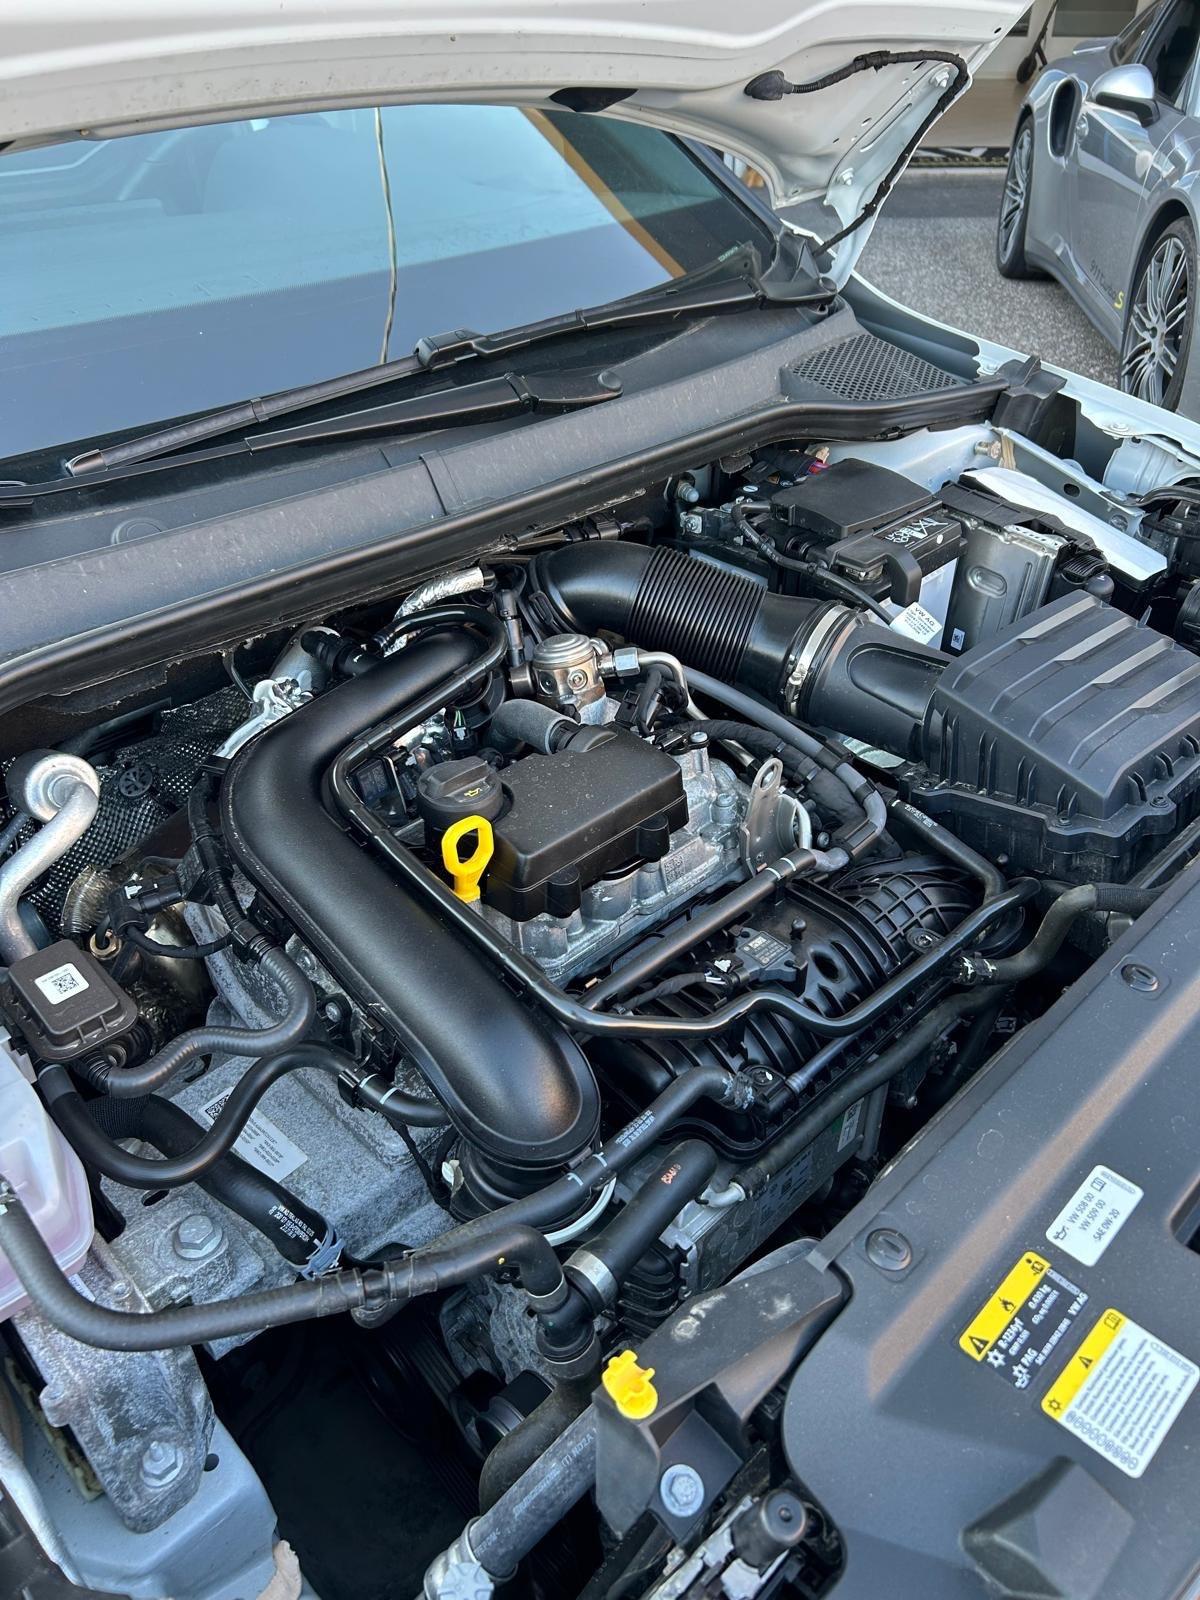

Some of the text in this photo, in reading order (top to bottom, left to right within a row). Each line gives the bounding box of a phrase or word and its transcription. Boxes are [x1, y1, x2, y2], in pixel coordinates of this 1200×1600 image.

[1114, 291, 1124, 308] S
[1065, 1191, 1095, 1224] VW 508 00
[1078, 1198, 1106, 1231] VW 509 00
[1092, 1227, 1106, 1241] SAE
[1100, 1208, 1120, 1230] 0W-20
[996, 1316, 1026, 1350] R-1234yf
[1039, 1282, 1052, 1293] kg
[1067, 1300, 1082, 1316] VW
[1075, 1291, 1089, 1305] AG
[1019, 1346, 1038, 1367] PAG
